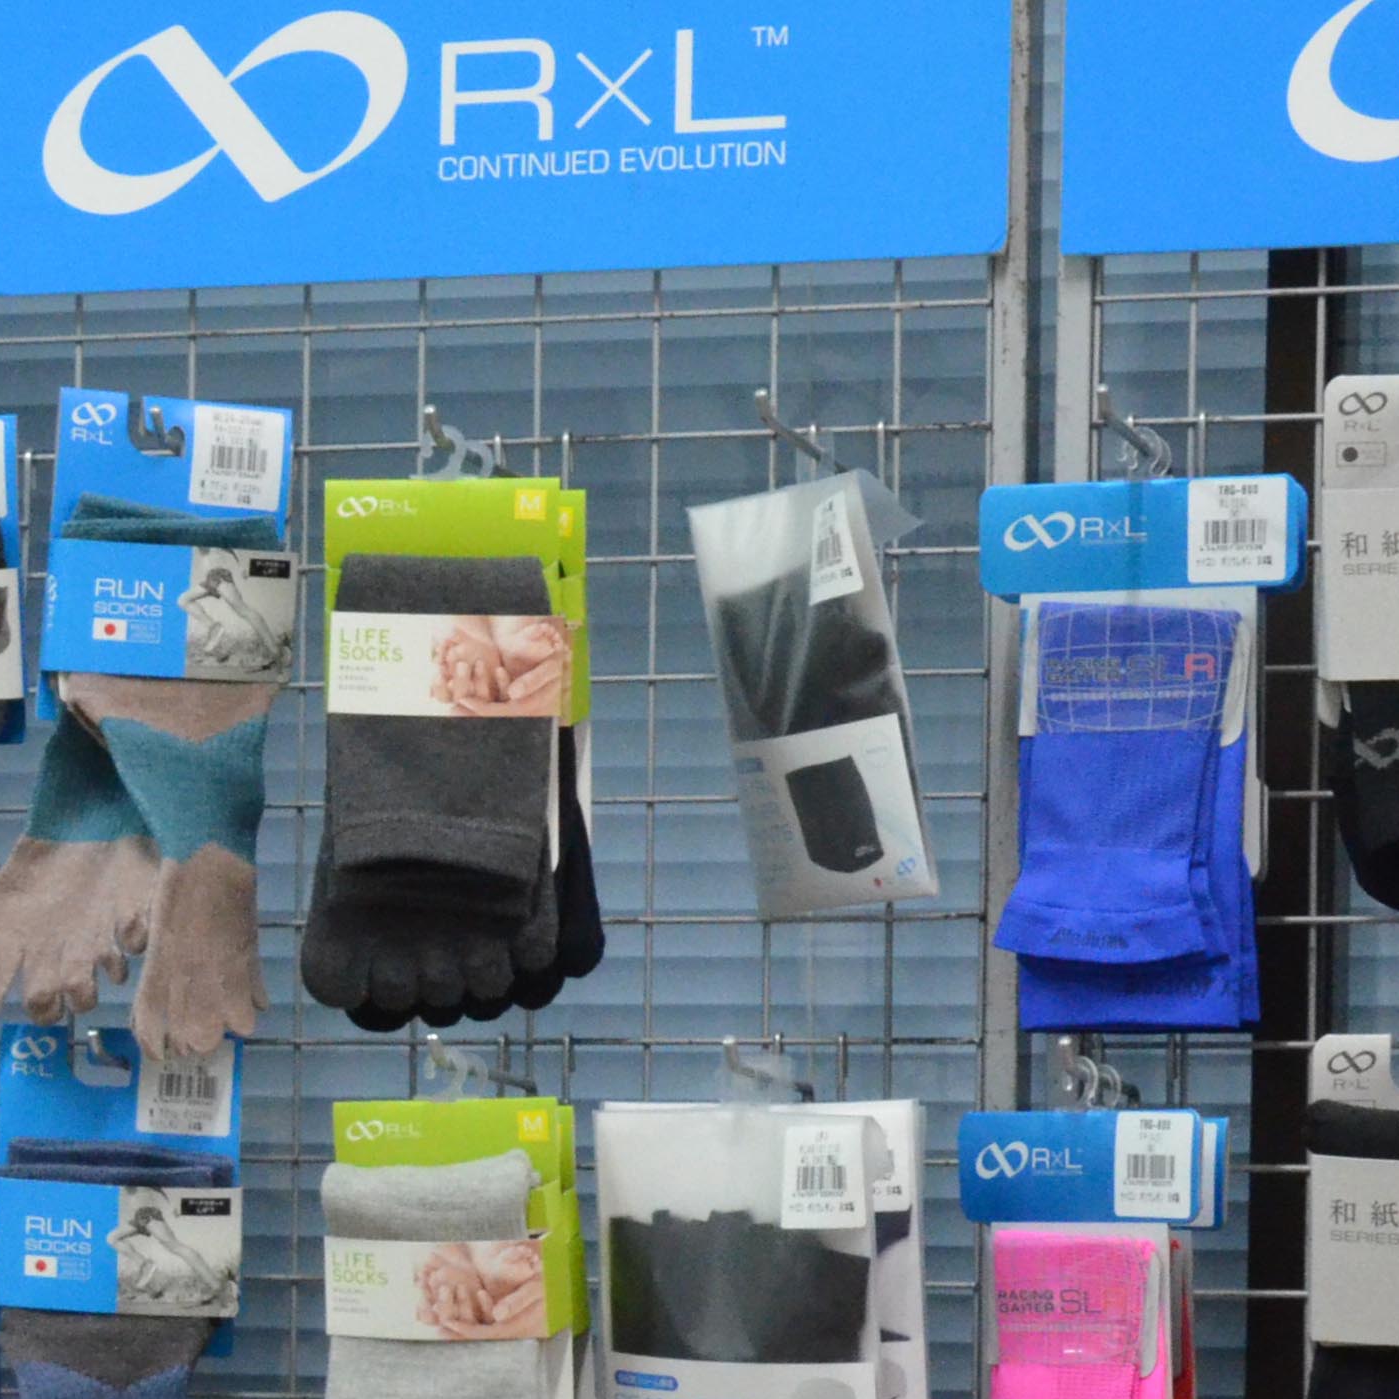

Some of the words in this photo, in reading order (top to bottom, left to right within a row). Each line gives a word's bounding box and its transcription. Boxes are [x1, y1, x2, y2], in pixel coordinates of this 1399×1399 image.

[439, 149, 610, 182] CONTINUED
[620, 141, 788, 174] EVOLUTION
[519, 494, 541, 514] M
[95, 577, 165, 601] RUN
[93, 602, 164, 618] SOCKS
[340, 628, 391, 645] LIFE
[339, 645, 404, 662] SOCKS
[523, 1114, 545, 1135] M
[25, 1216, 92, 1239] RUN
[24, 1239, 92, 1256] SOCKS
[331, 1251, 375, 1268] LIFE
[331, 1267, 389, 1286] SOCKS
[996, 1289, 1054, 1300] RACING
[997, 1301, 1055, 1314] GAITER
